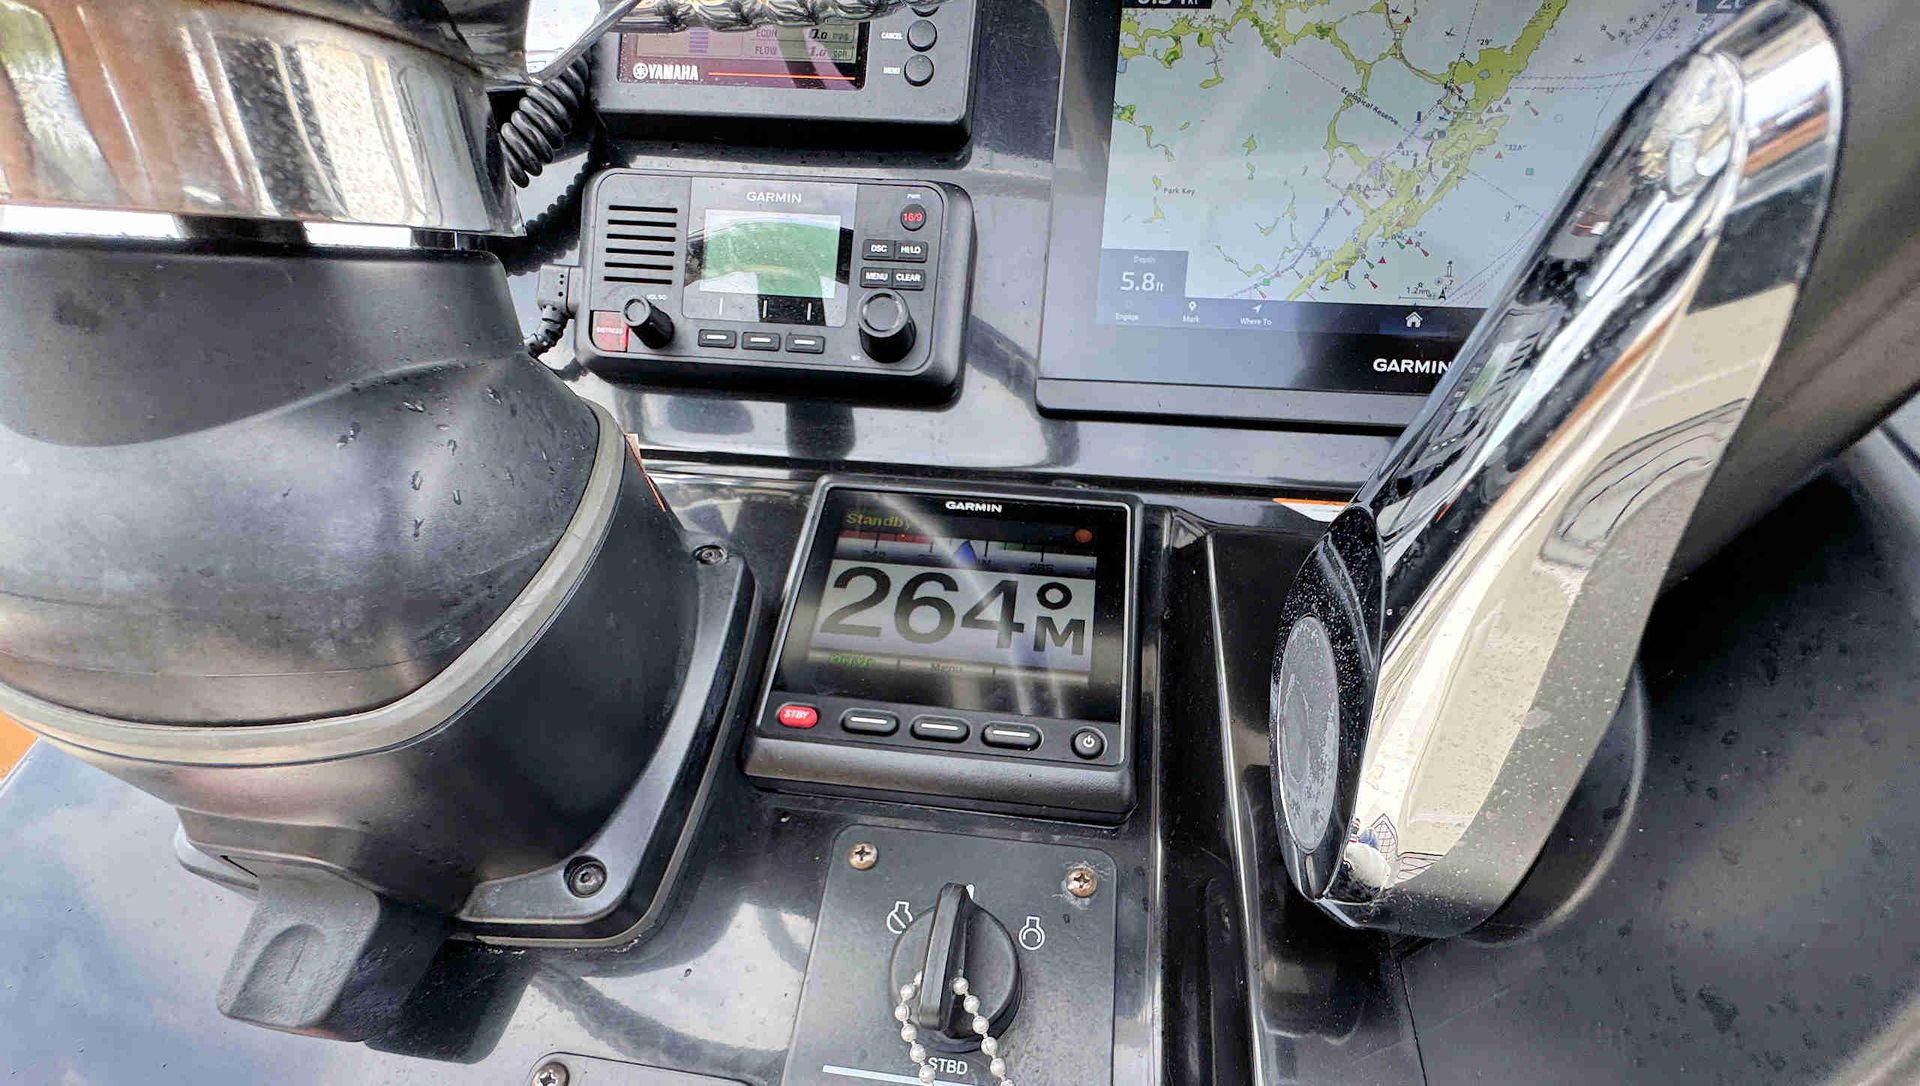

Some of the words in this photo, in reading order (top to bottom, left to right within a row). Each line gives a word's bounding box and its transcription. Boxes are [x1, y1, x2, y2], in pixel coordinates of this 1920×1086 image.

[756, 28, 778, 38] ECON
[881, 32, 903, 40] CANCEL
[755, 45, 778, 55] FLOW
[648, 63, 699, 81] YAMAHA
[1341, 86, 1374, 109] Ecological
[1373, 106, 1399, 126] Reserve
[746, 191, 802, 203] GARMIN
[1182, 187, 1196, 197] Key
[870, 244, 888, 253] DSC
[865, 271, 889, 281] MENU
[895, 272, 921, 282] CLEAR
[1240, 317, 1262, 325] Where
[1263, 318, 1273, 326] To
[1372, 358, 1453, 375] GARMIN
[945, 501, 1003, 514] GARMIN
[847, 510, 911, 531] Standby
[1033, 615, 1086, 656] M
[931, 662, 962, 673] Menu
[783, 709, 810, 720] STBY
[927, 1056, 968, 1075] STBD
